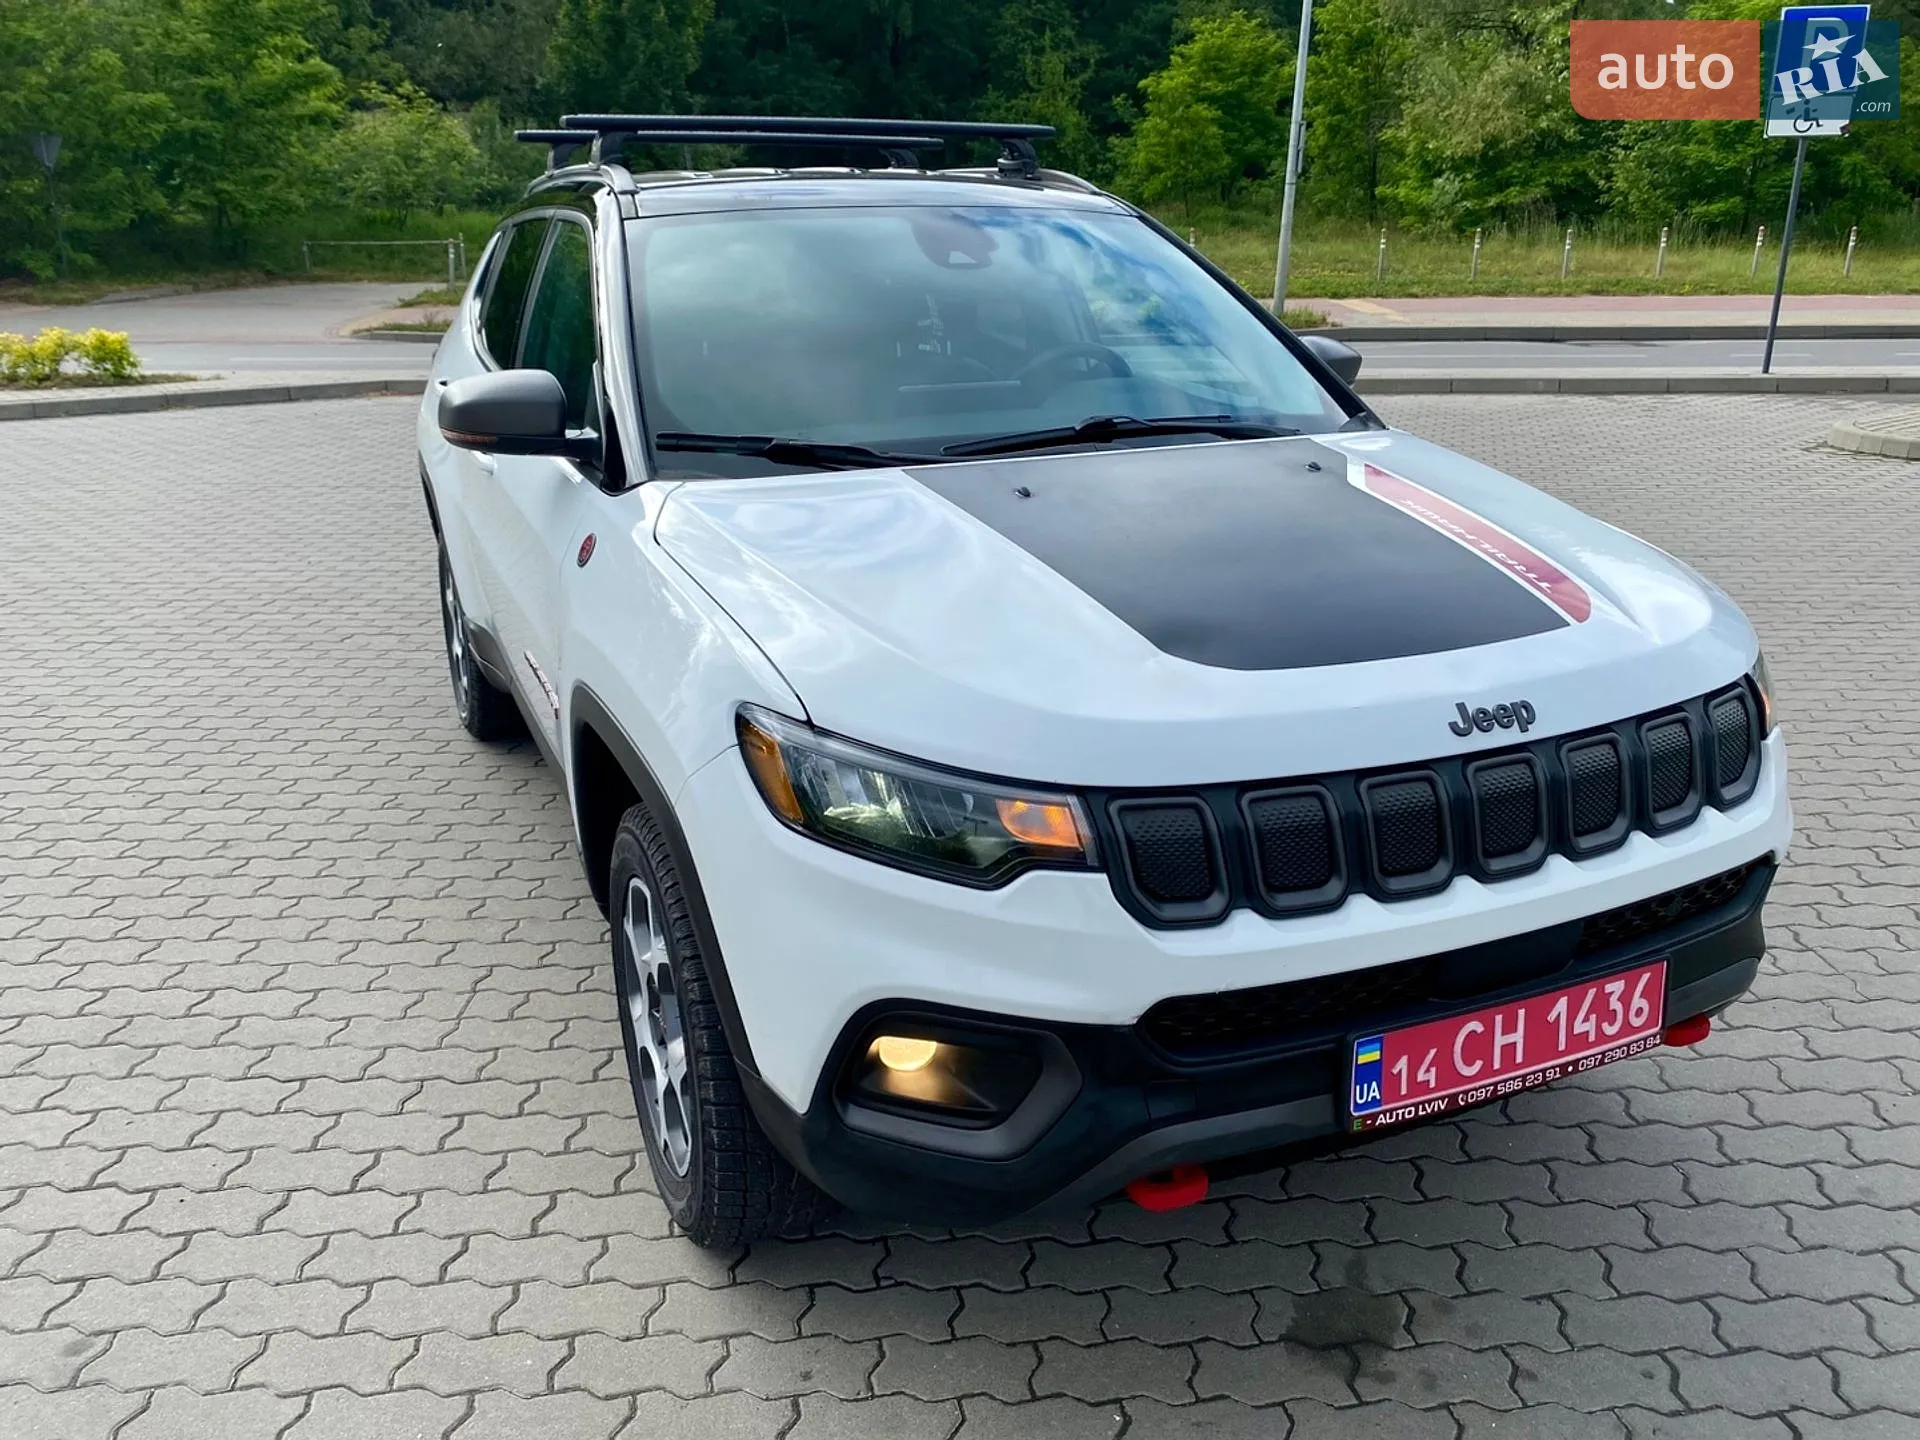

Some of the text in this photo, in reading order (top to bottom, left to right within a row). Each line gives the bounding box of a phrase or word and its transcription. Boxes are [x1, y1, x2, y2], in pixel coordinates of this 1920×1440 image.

[1448, 700, 1536, 737] Jeep
[1391, 972, 1652, 1096] 14 CH 1436
[1356, 1080, 1381, 1105] UA
[1375, 1106, 1415, 1126] AUTO
[1418, 1098, 1448, 1116] LVIV
[1467, 1086, 1493, 1103] 097
[1497, 1079, 1523, 1095] 586
[1525, 1072, 1543, 1087] 23
[1545, 1067, 1561, 1079] 91
[1578, 1054, 1602, 1072] 097
[1604, 1048, 1628, 1063] 290
[1645, 1034, 1661, 1048] 84
